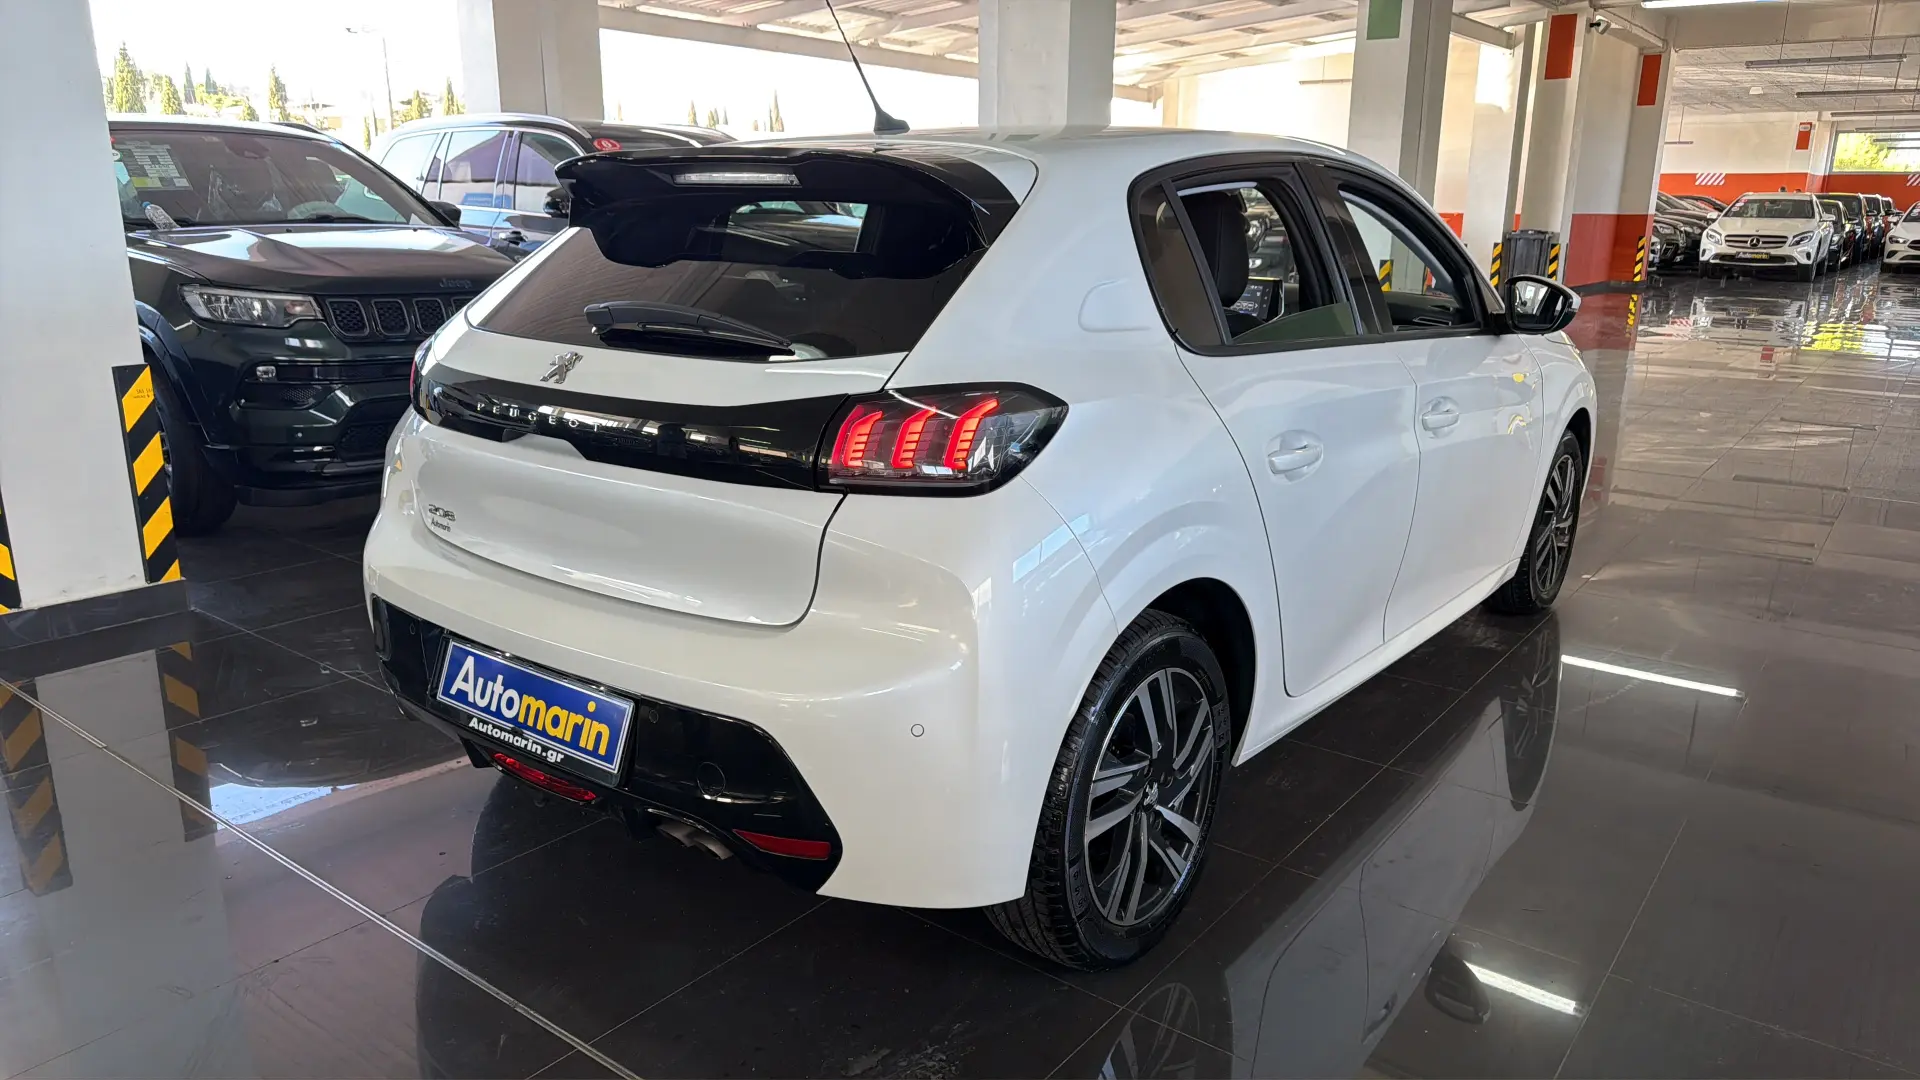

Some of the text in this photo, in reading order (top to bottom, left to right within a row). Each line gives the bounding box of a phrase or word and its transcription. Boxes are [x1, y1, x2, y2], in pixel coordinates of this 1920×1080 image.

[477, 402, 600, 432] PEUGEOT
[428, 503, 456, 521] 208
[449, 655, 610, 756] Automarin
[468, 717, 565, 763] Automarin.gr
